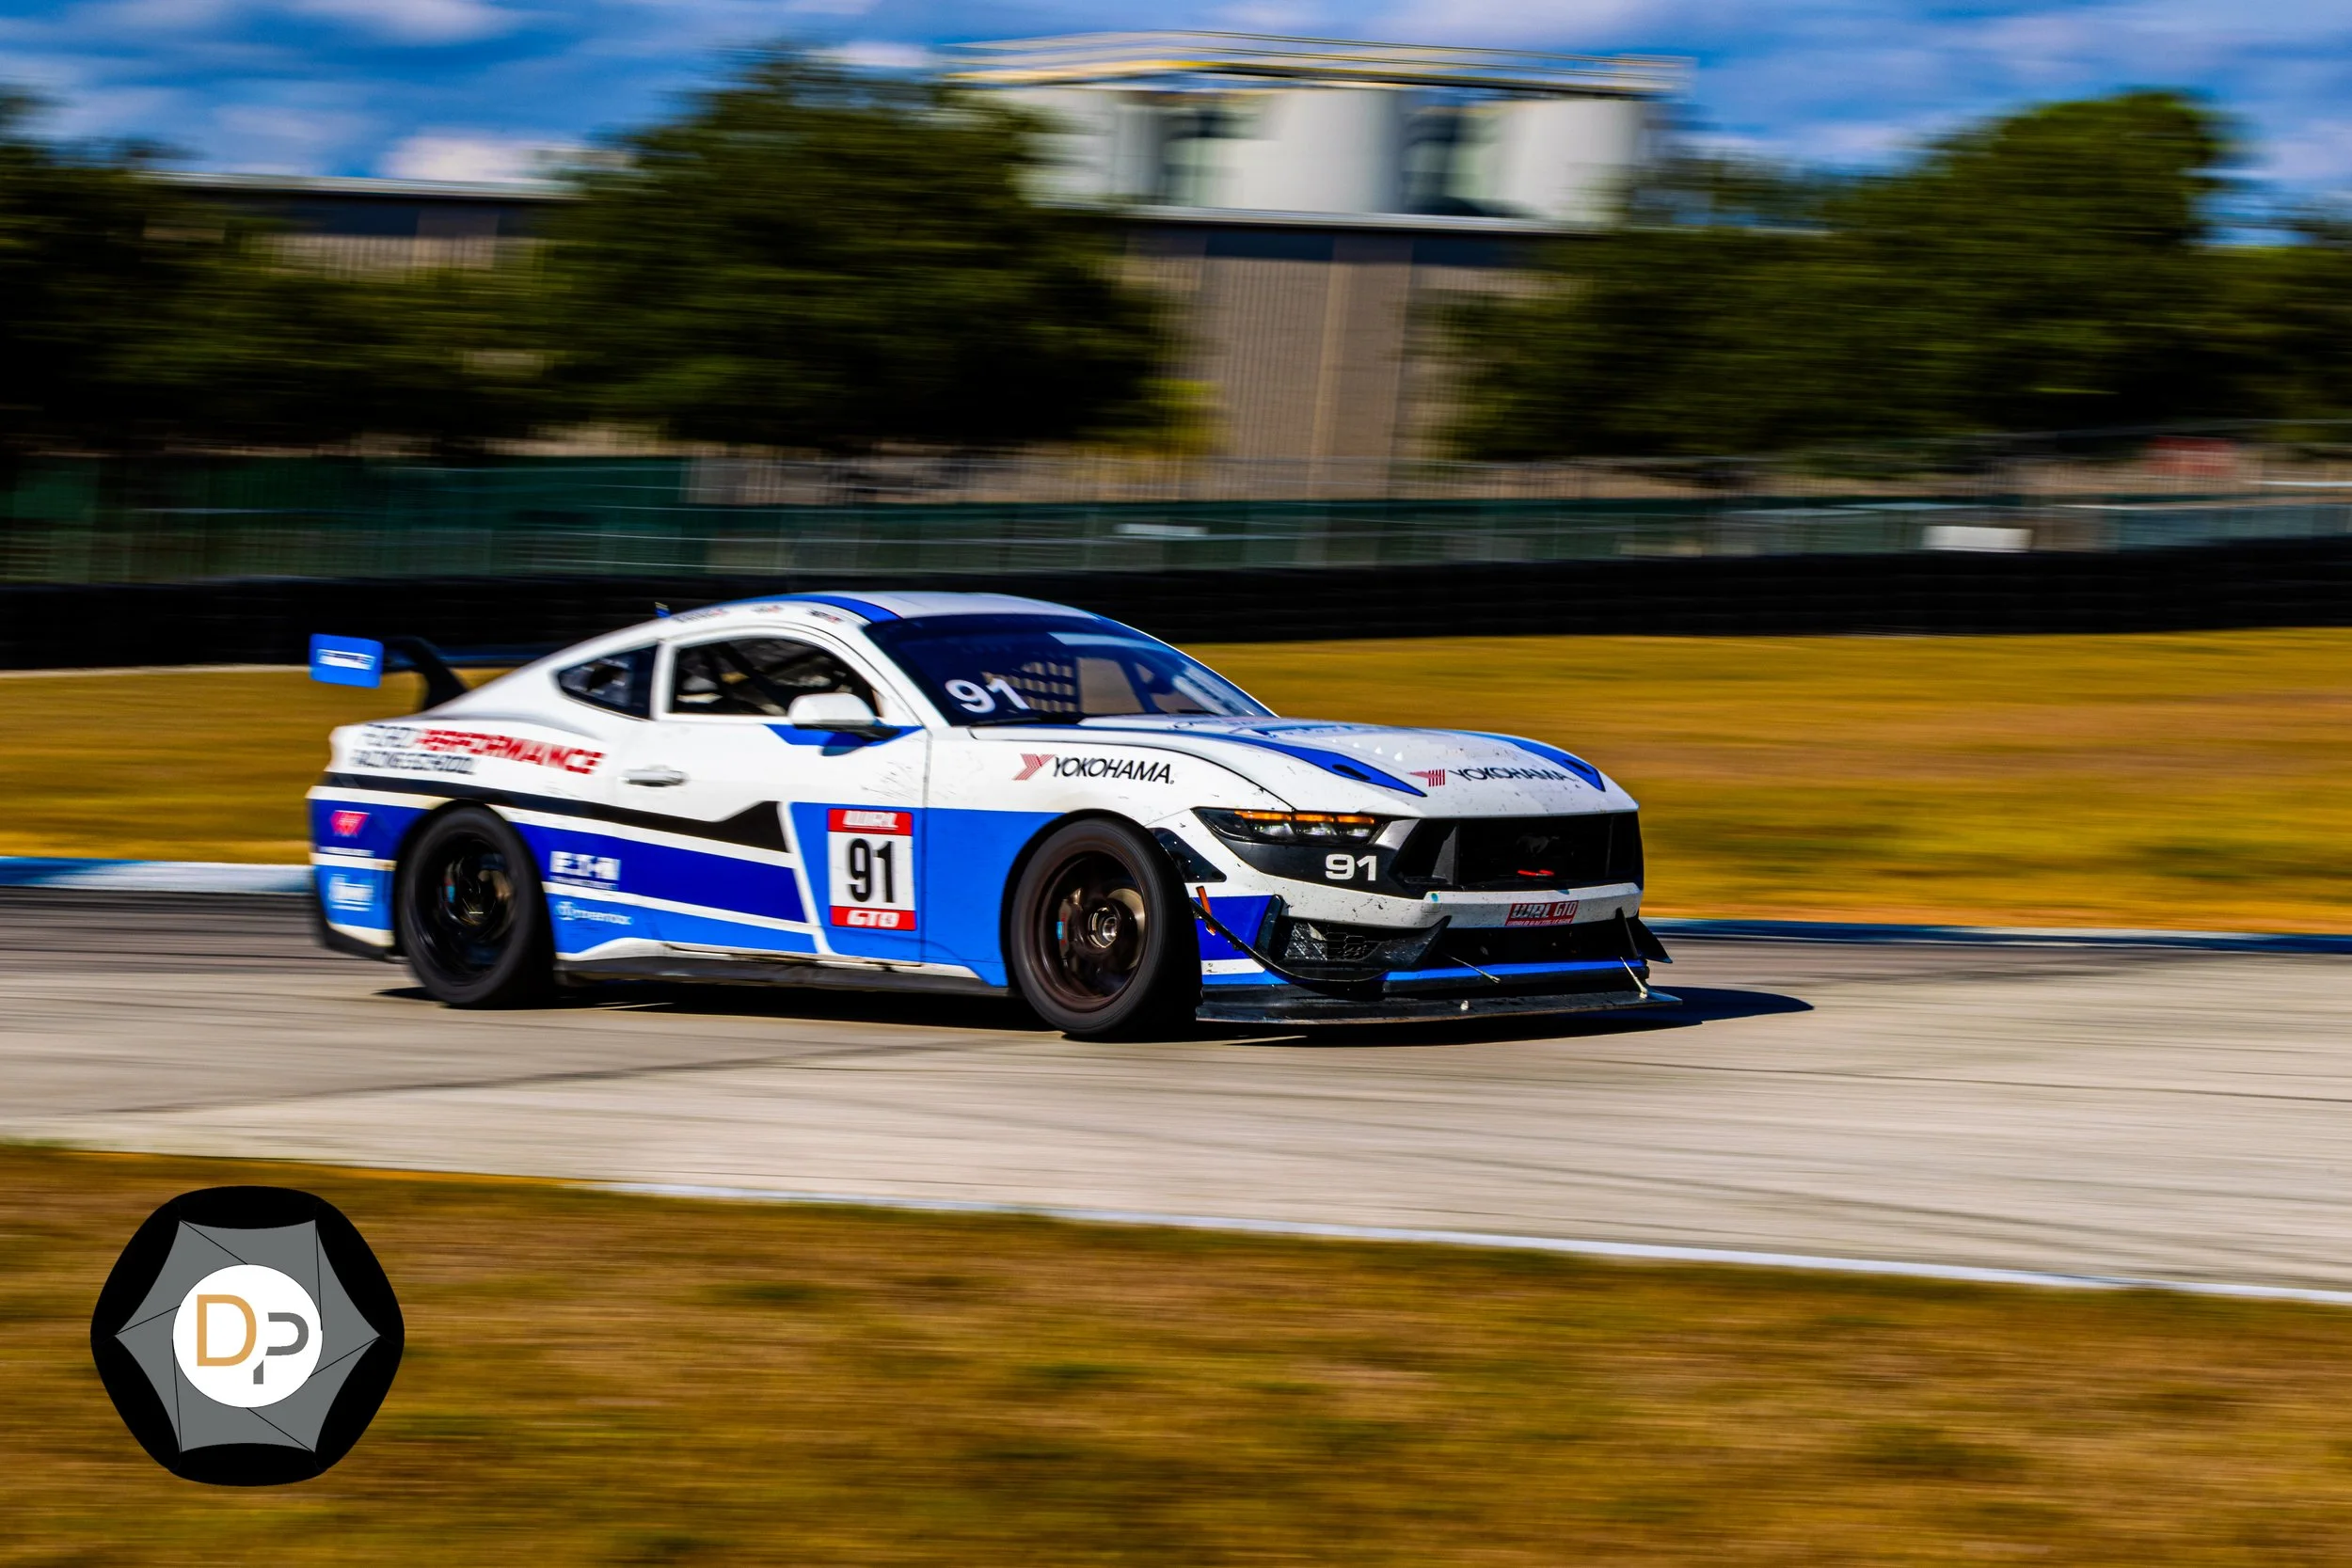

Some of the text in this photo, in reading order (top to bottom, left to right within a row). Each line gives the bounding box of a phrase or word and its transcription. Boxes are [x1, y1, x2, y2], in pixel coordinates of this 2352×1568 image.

[945, 677, 1030, 714] 91
[1053, 756, 1171, 784] YOKOHAMA
[1448, 767, 1577, 782] YOKOHAMA
[847, 838, 896, 903] 91
[1326, 854, 1376, 880] 91
[847, 910, 900, 927] GTO
